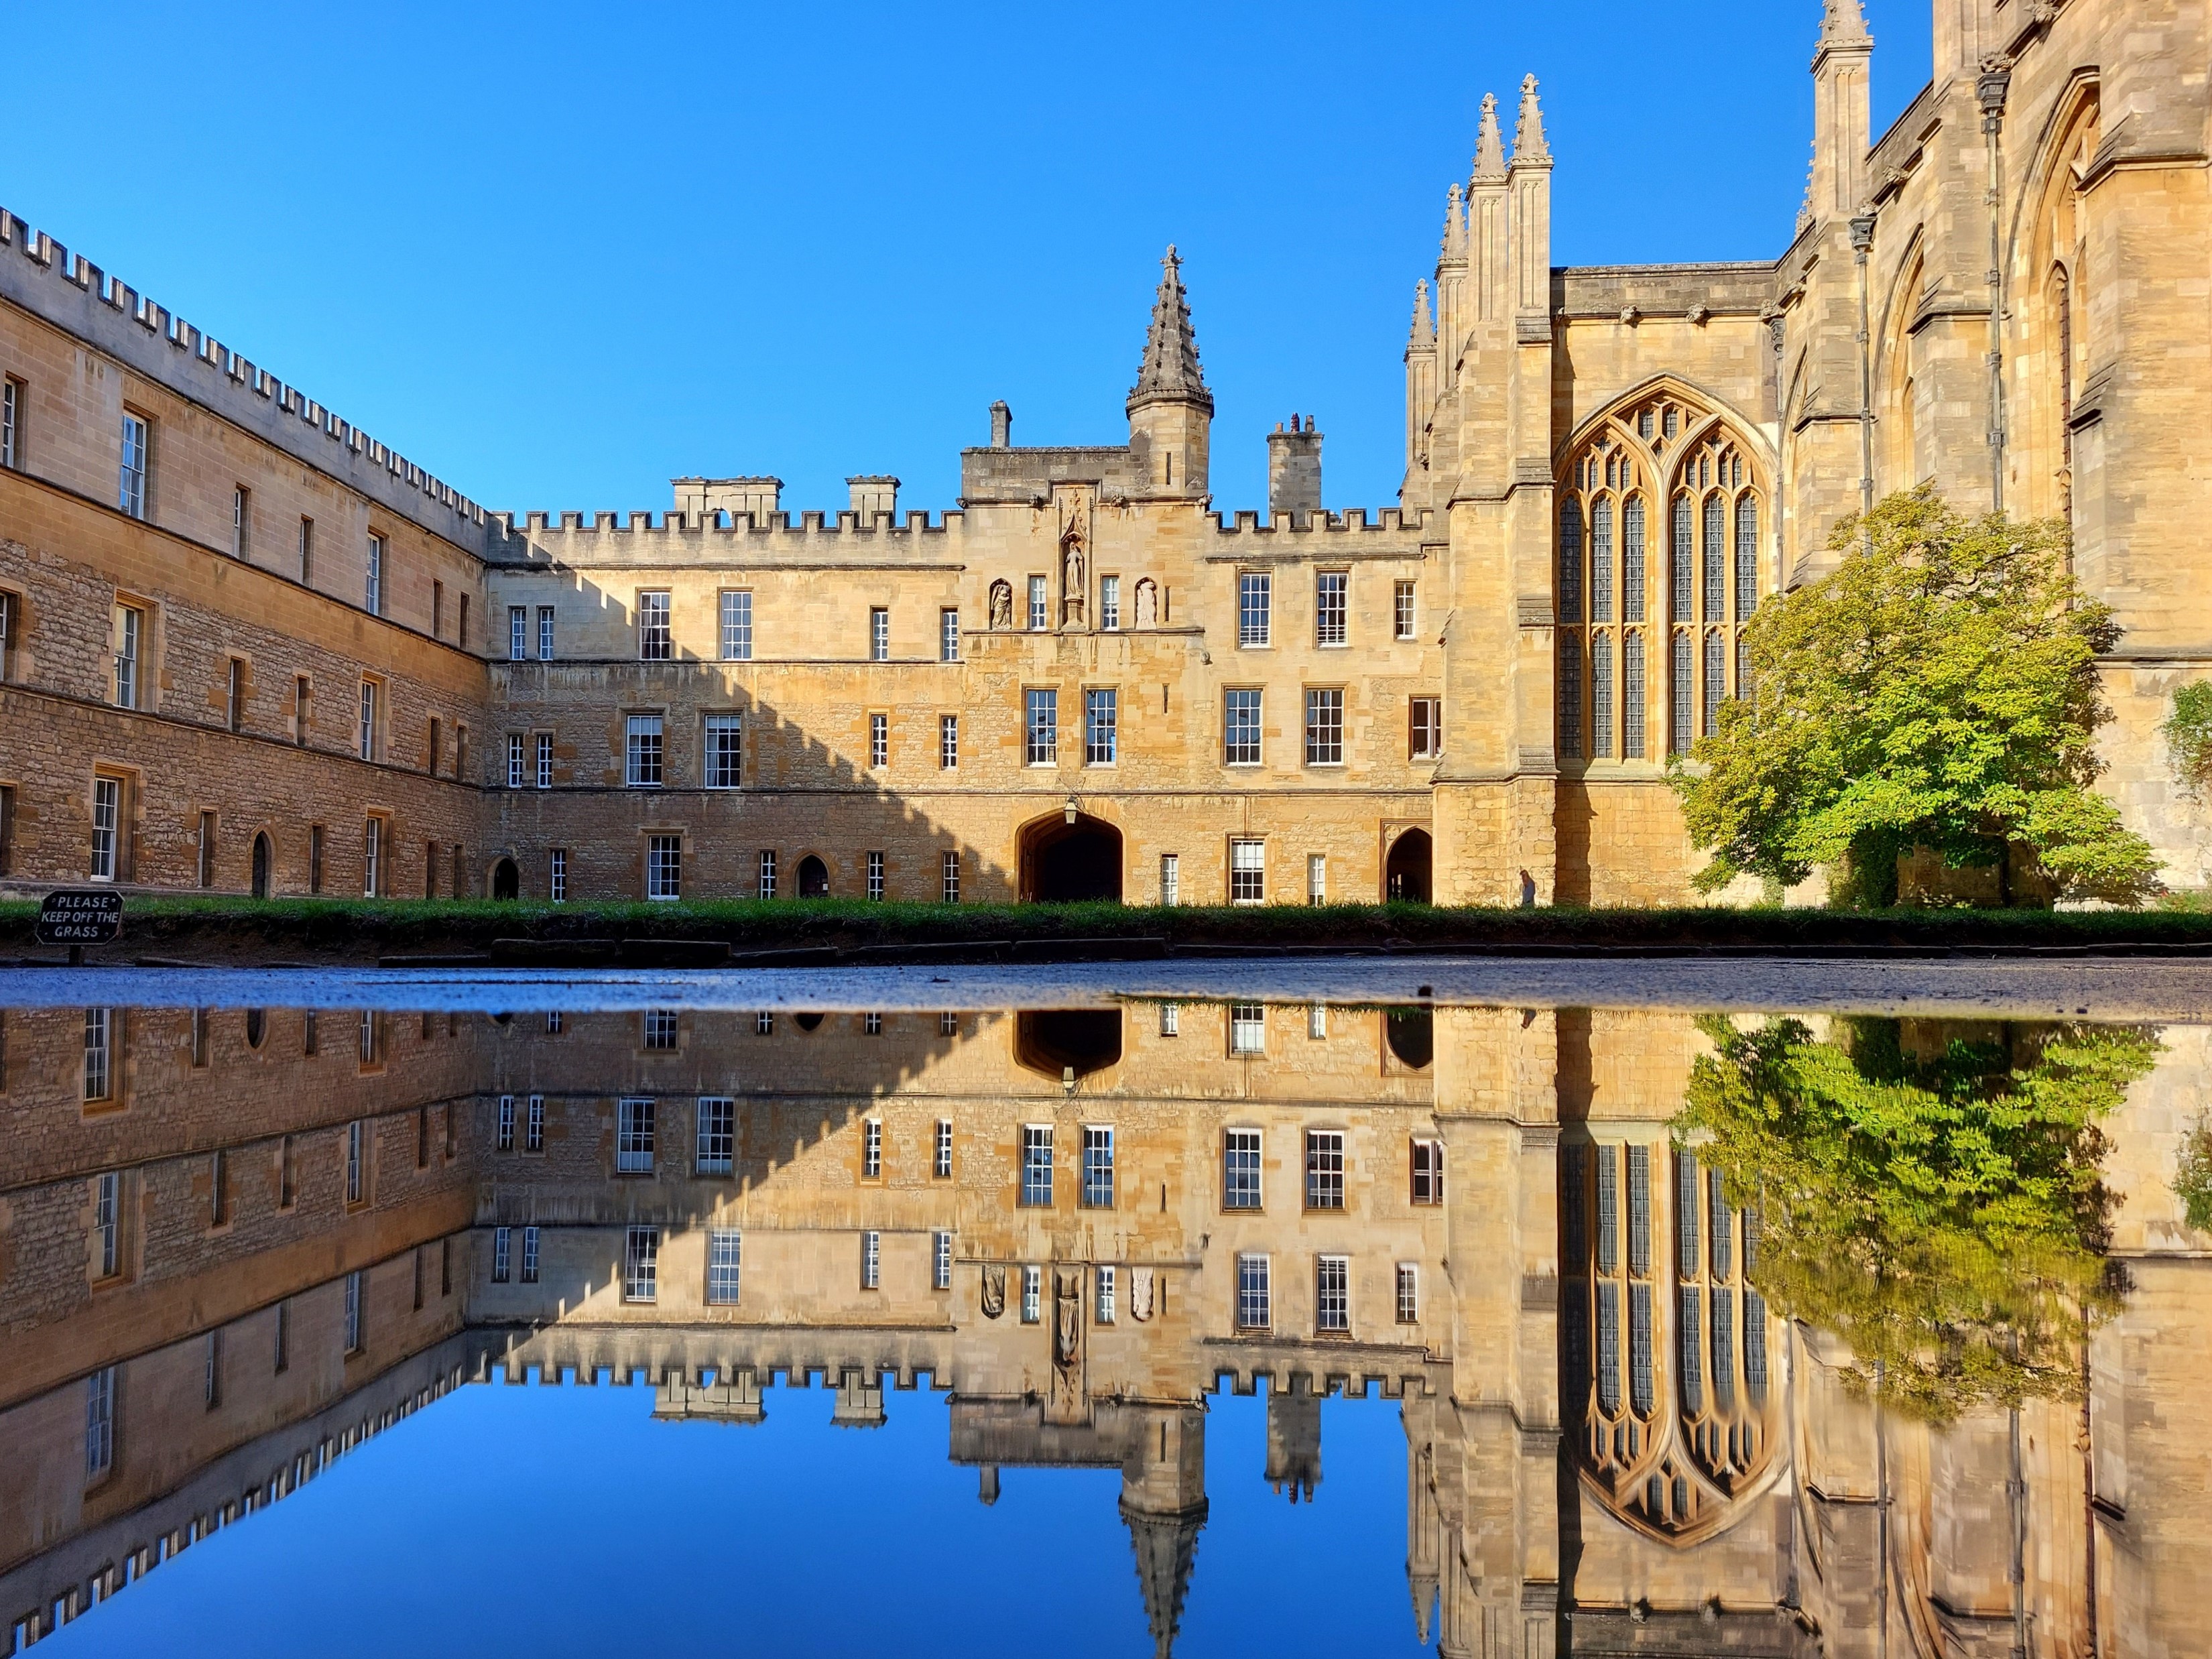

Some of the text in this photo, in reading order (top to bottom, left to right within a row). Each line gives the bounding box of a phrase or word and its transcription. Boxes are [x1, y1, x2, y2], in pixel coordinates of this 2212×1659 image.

[58, 897, 109, 908] PLEASE
[42, 912, 119, 923] KEEP OFF THE
[54, 926, 99, 937] GRASS
